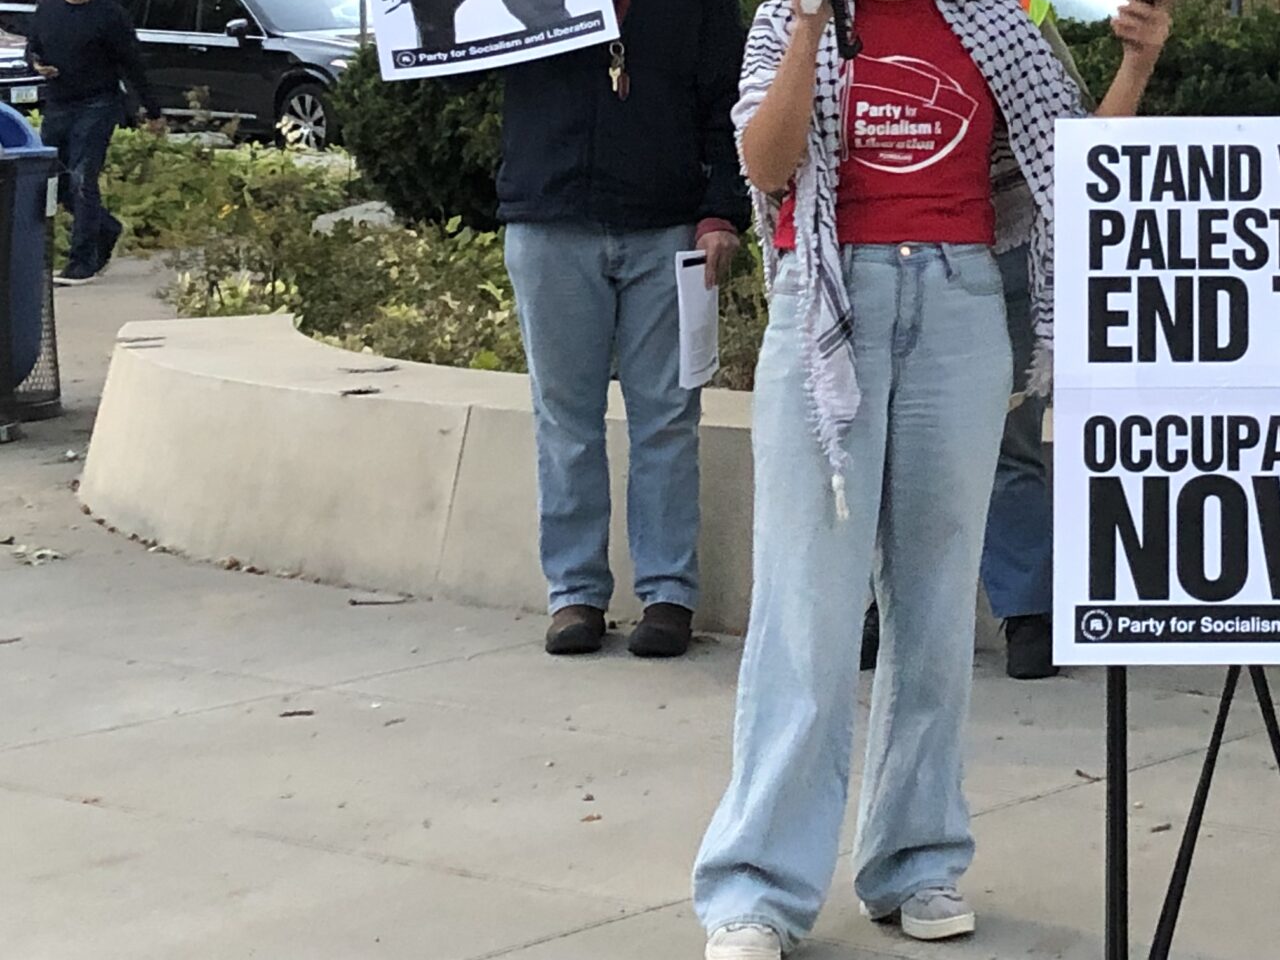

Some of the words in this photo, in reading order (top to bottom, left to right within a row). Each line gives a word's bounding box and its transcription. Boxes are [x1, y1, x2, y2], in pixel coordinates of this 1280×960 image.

[418, 51, 448, 62] Party
[450, 48, 466, 58] for
[468, 38, 522, 56] Socialism
[524, 32, 545, 44] and
[546, 19, 601, 38] Liberation
[856, 101, 901, 119] Party
[854, 120, 932, 135] Socialism
[1086, 144, 1262, 202] STAND
[1088, 276, 1249, 363] END
[1118, 617, 1165, 634] Party
[1170, 617, 1195, 632] for
